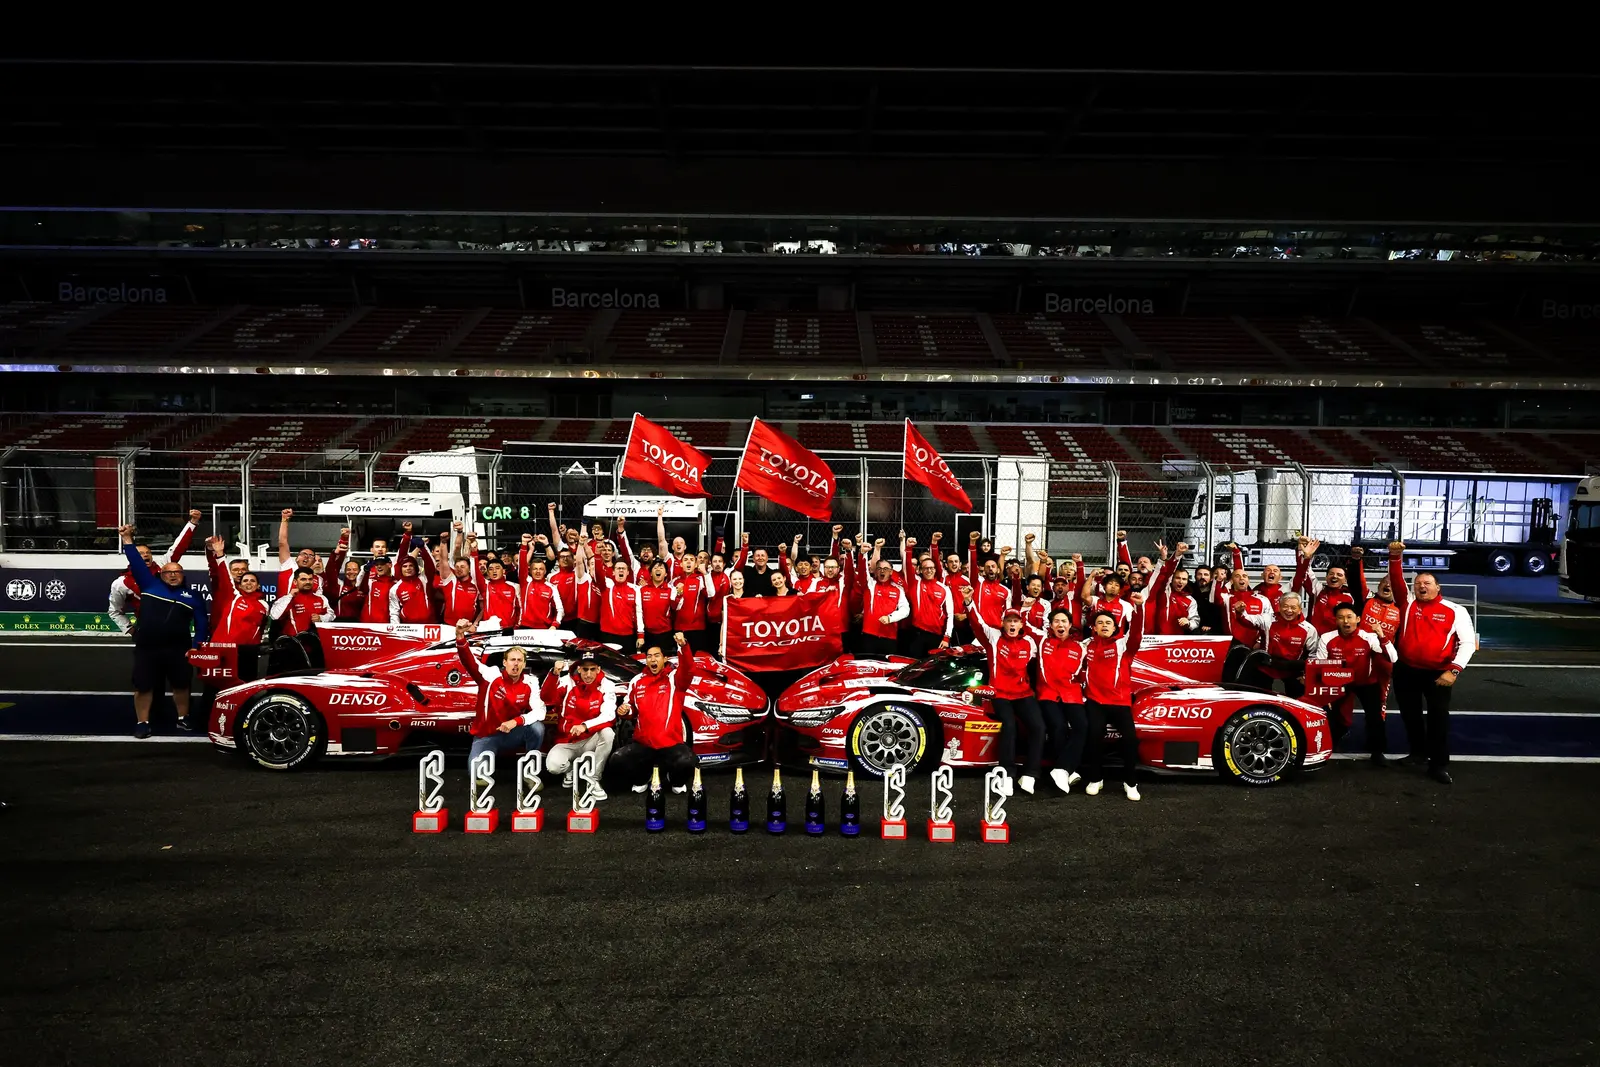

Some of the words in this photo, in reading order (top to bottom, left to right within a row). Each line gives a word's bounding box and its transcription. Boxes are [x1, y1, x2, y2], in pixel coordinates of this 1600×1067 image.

[58, 281, 167, 302] Barcelona
[551, 287, 660, 308] Barcelona
[1045, 292, 1154, 314] Barcelona
[642, 439, 698, 482] TOYOTA
[760, 447, 829, 494] TOYOTA
[756, 464, 826, 498] RACING
[482, 506, 512, 519] CAR
[520, 506, 529, 519] 8
[8, 584, 32, 596] FIA
[424, 627, 440, 639] HY
[742, 616, 825, 638] TOYOTA
[332, 635, 382, 646] TOYOTA
[741, 634, 825, 648] RACING
[1165, 647, 1215, 659] TOYOTA
[202, 668, 232, 677] JFE
[974, 688, 994, 696] DENSO
[1308, 686, 1339, 695] JFE
[328, 693, 387, 706] DENSO
[246, 698, 269, 719] MICHELIN
[1153, 706, 1212, 719] DENSO
[894, 706, 920, 726] MICHELIN
[1257, 711, 1284, 721] MICHELIN
[1306, 720, 1319, 728] Mobil
[979, 736, 994, 756] 7
[289, 745, 310, 767] MICHELIN
